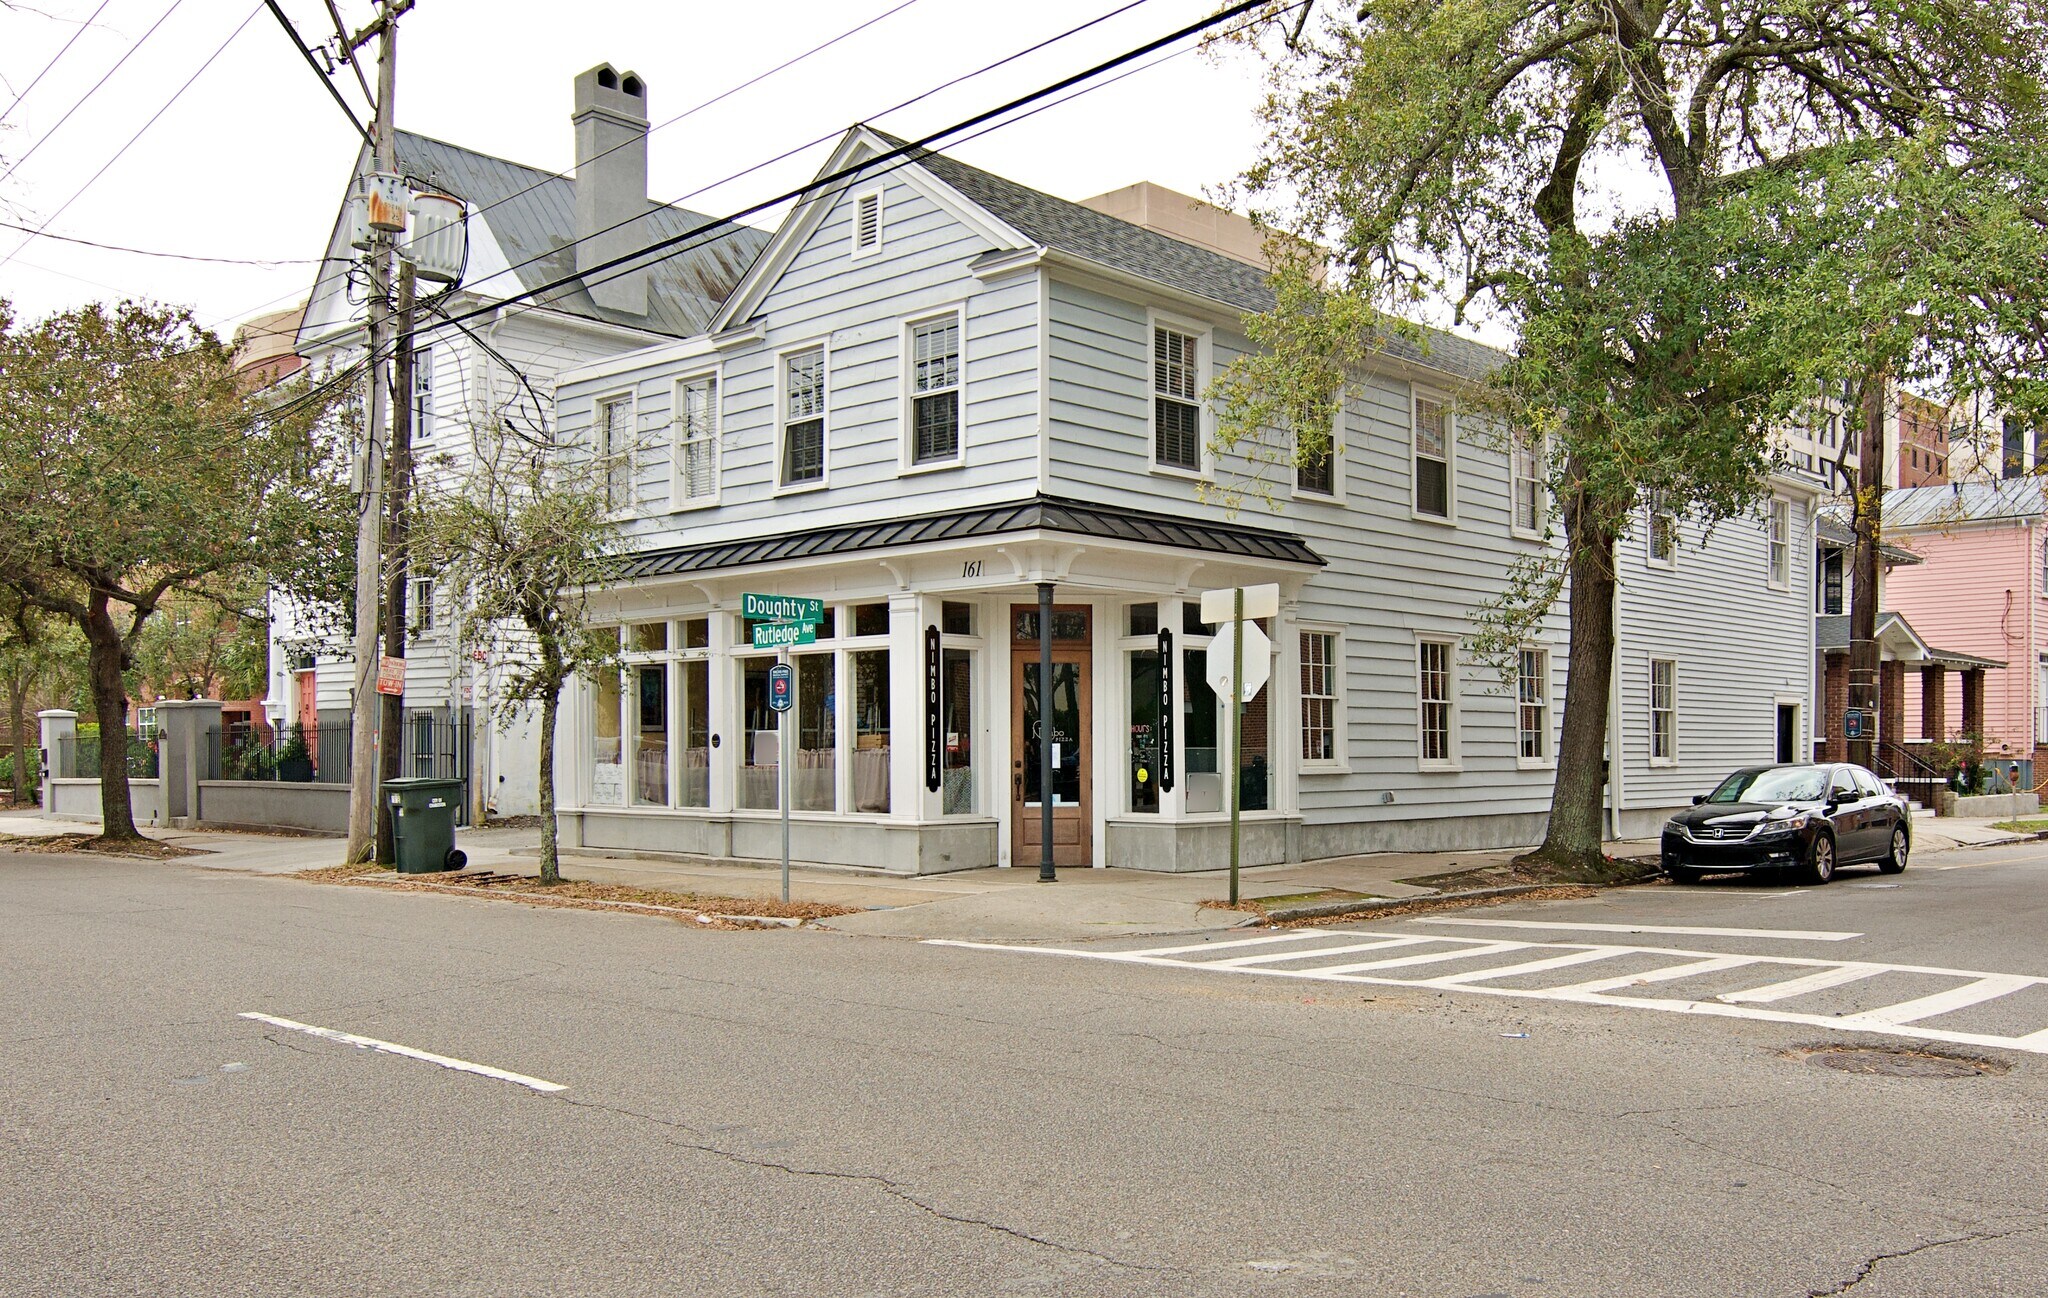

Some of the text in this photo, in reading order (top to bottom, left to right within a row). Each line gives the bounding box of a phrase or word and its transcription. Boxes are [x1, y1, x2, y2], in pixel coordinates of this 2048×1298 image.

[962, 560, 981, 578] 161
[747, 595, 819, 620] Doughty St
[755, 622, 814, 644] Rutledge Ave
[379, 678, 403, 688] TOW-IN
